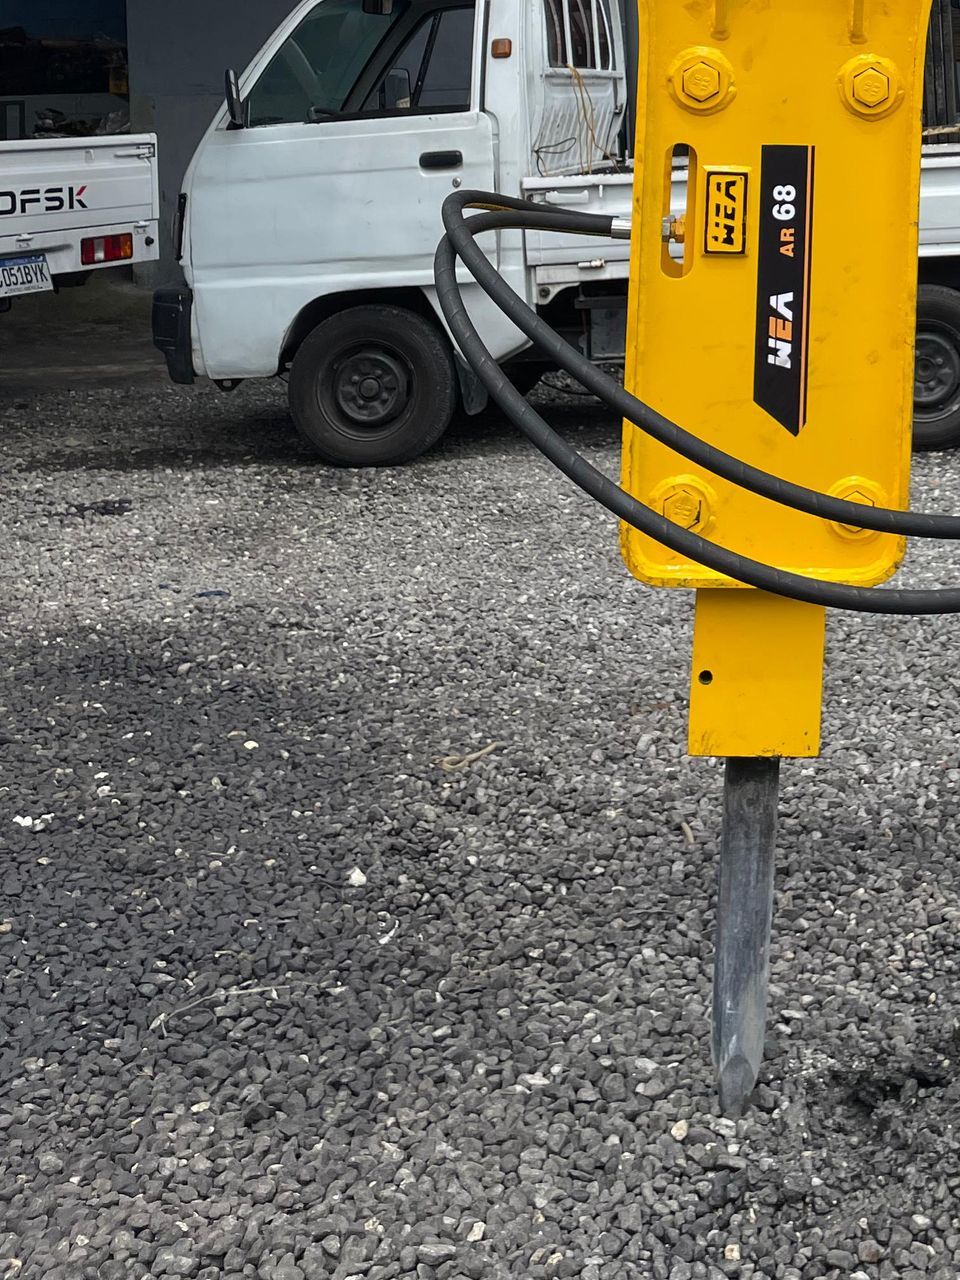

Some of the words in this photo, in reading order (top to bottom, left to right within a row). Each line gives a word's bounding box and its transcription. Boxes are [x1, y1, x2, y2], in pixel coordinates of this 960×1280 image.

[772, 184, 797, 221] 68
[779, 227, 795, 258] AR
[767, 291, 794, 369] WEA
